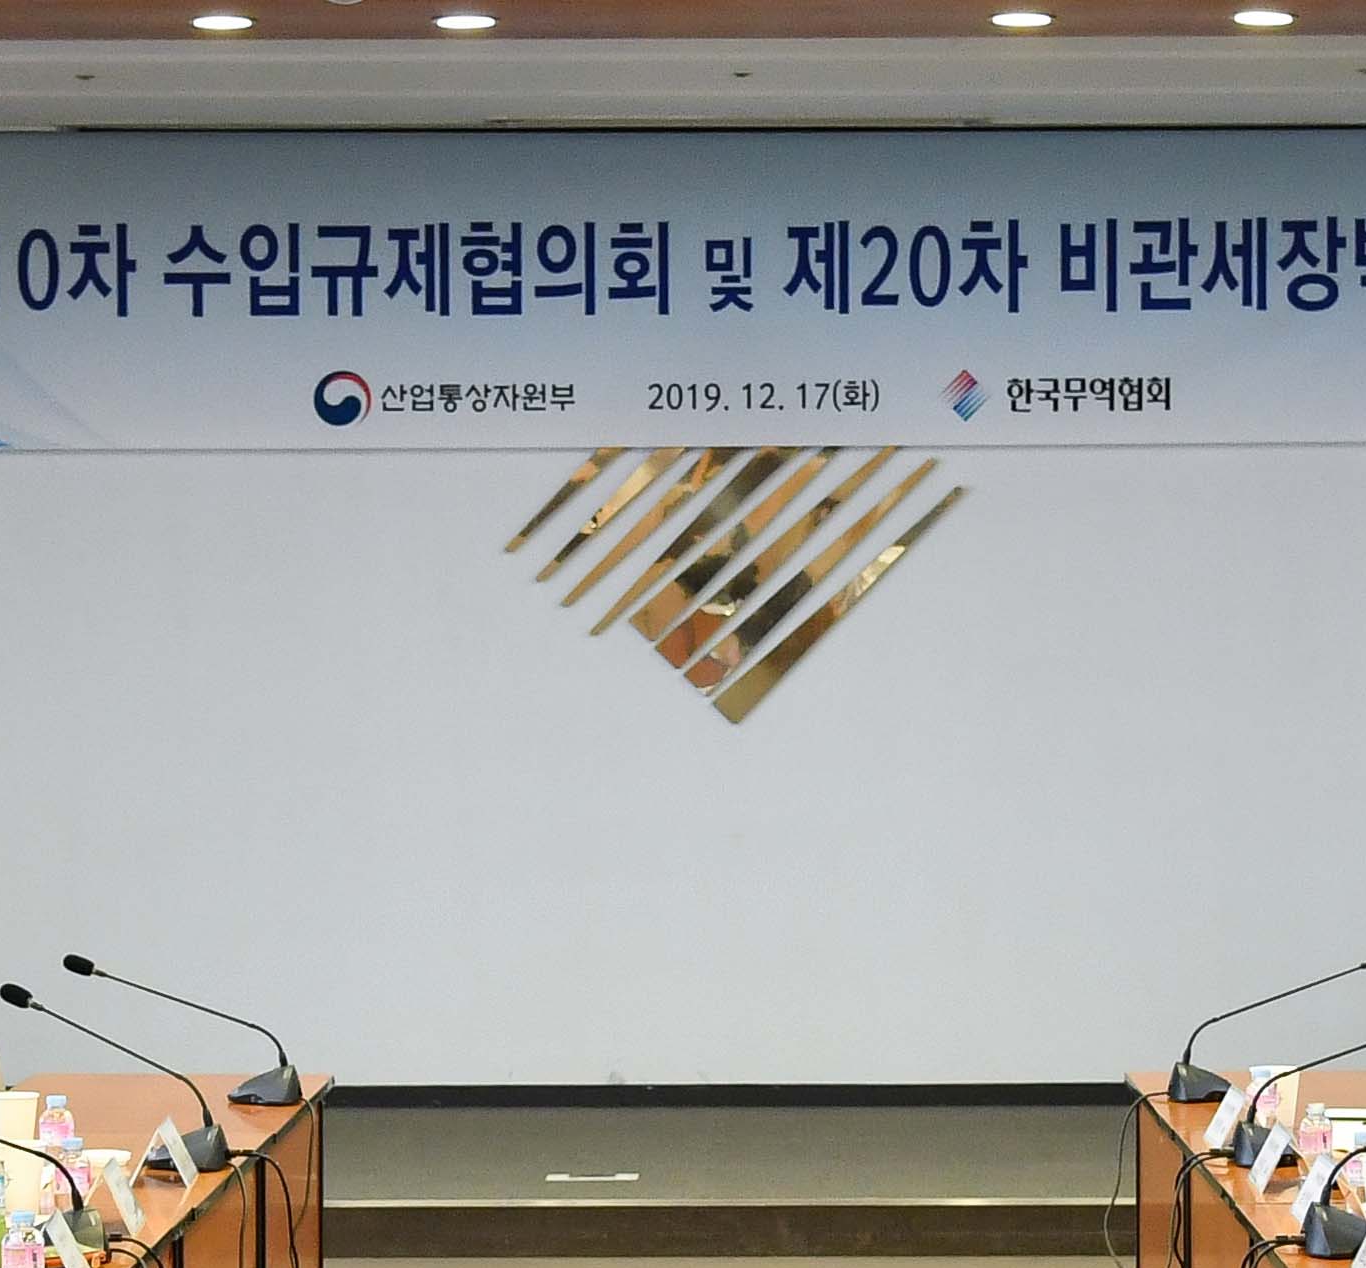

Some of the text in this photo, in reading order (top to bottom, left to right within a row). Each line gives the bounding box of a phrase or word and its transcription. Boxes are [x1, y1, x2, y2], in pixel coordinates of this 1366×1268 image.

[163, 220, 671, 317] 수입규제협의회
[705, 236, 755, 312] 및
[783, 218, 1030, 314] 제20차
[381, 382, 577, 415] 산업통상자원부
[648, 379, 881, 414] 2019. 12. 17(화)
[1007, 377, 1172, 414] 한국무역협회
